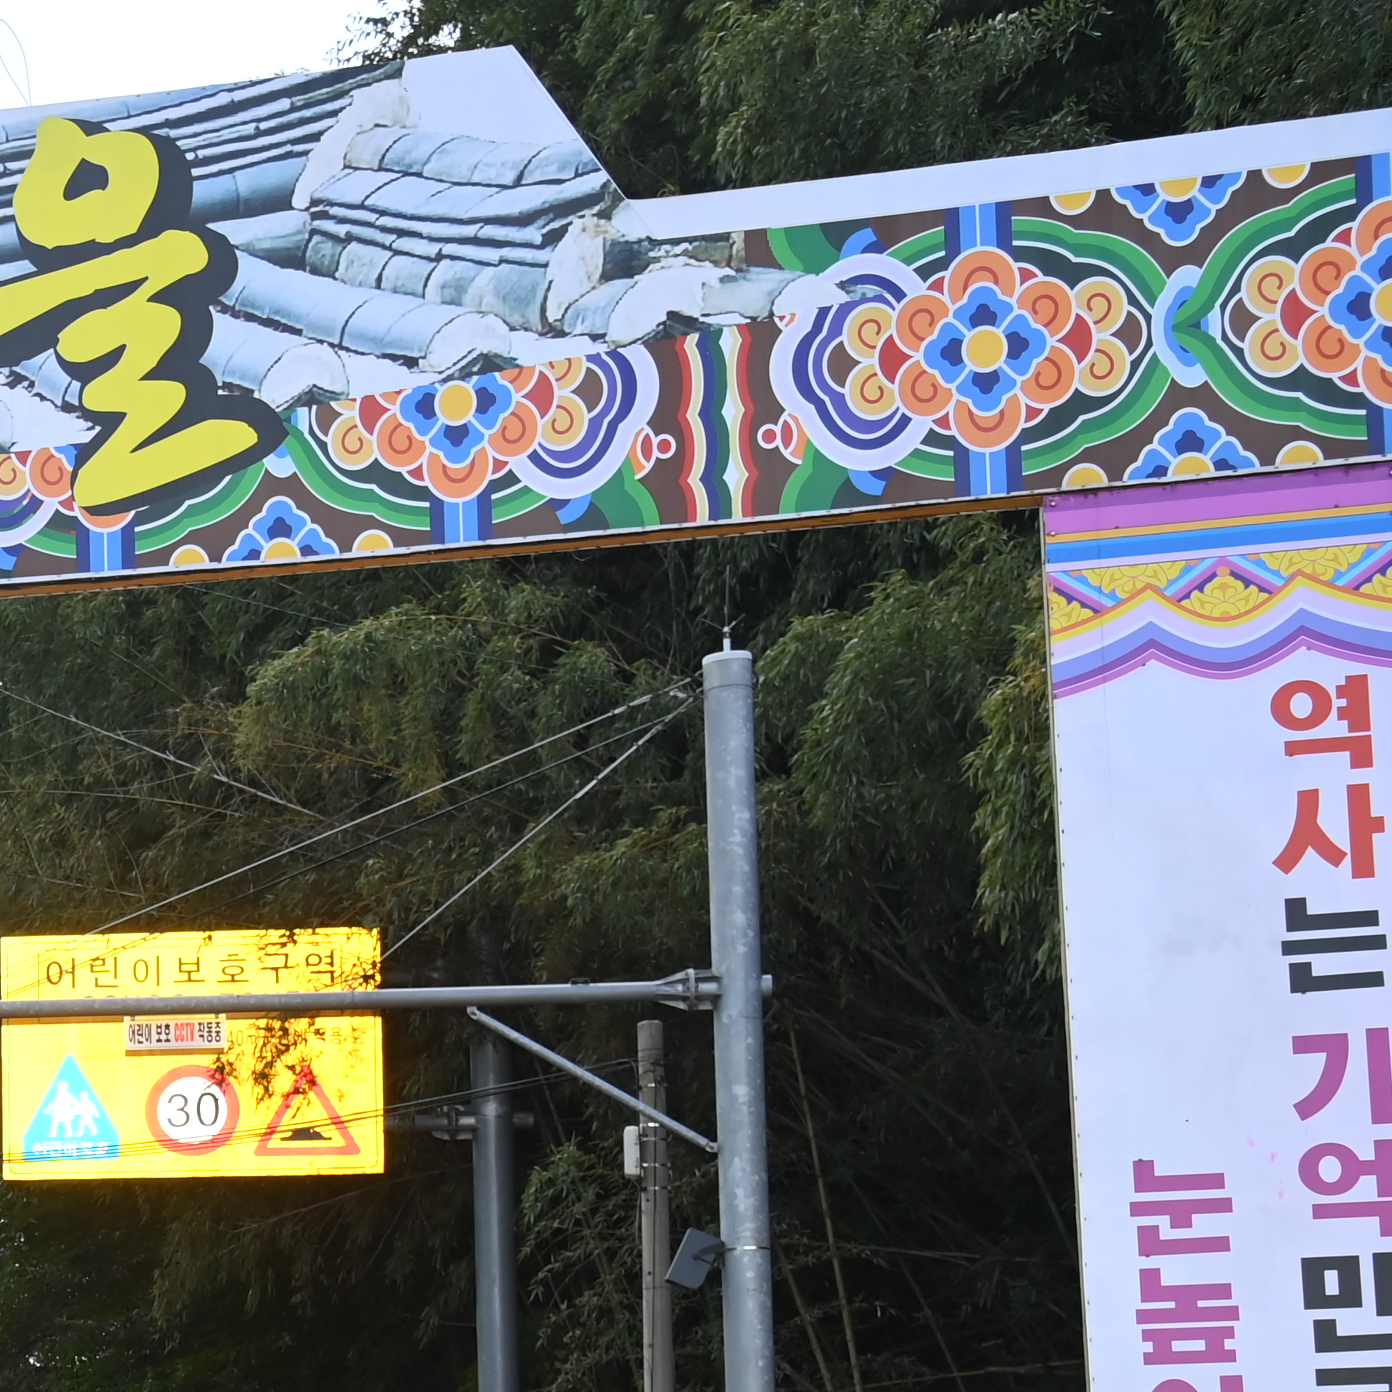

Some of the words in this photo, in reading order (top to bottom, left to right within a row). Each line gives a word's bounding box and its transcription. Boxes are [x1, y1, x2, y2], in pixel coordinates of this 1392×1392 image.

[1270, 673, 1388, 995] 역사는
[127, 1023, 153, 1045] 어린이
[155, 1022, 172, 1044] 보호
[173, 1022, 196, 1043] CCTV
[166, 1091, 220, 1128] 30
